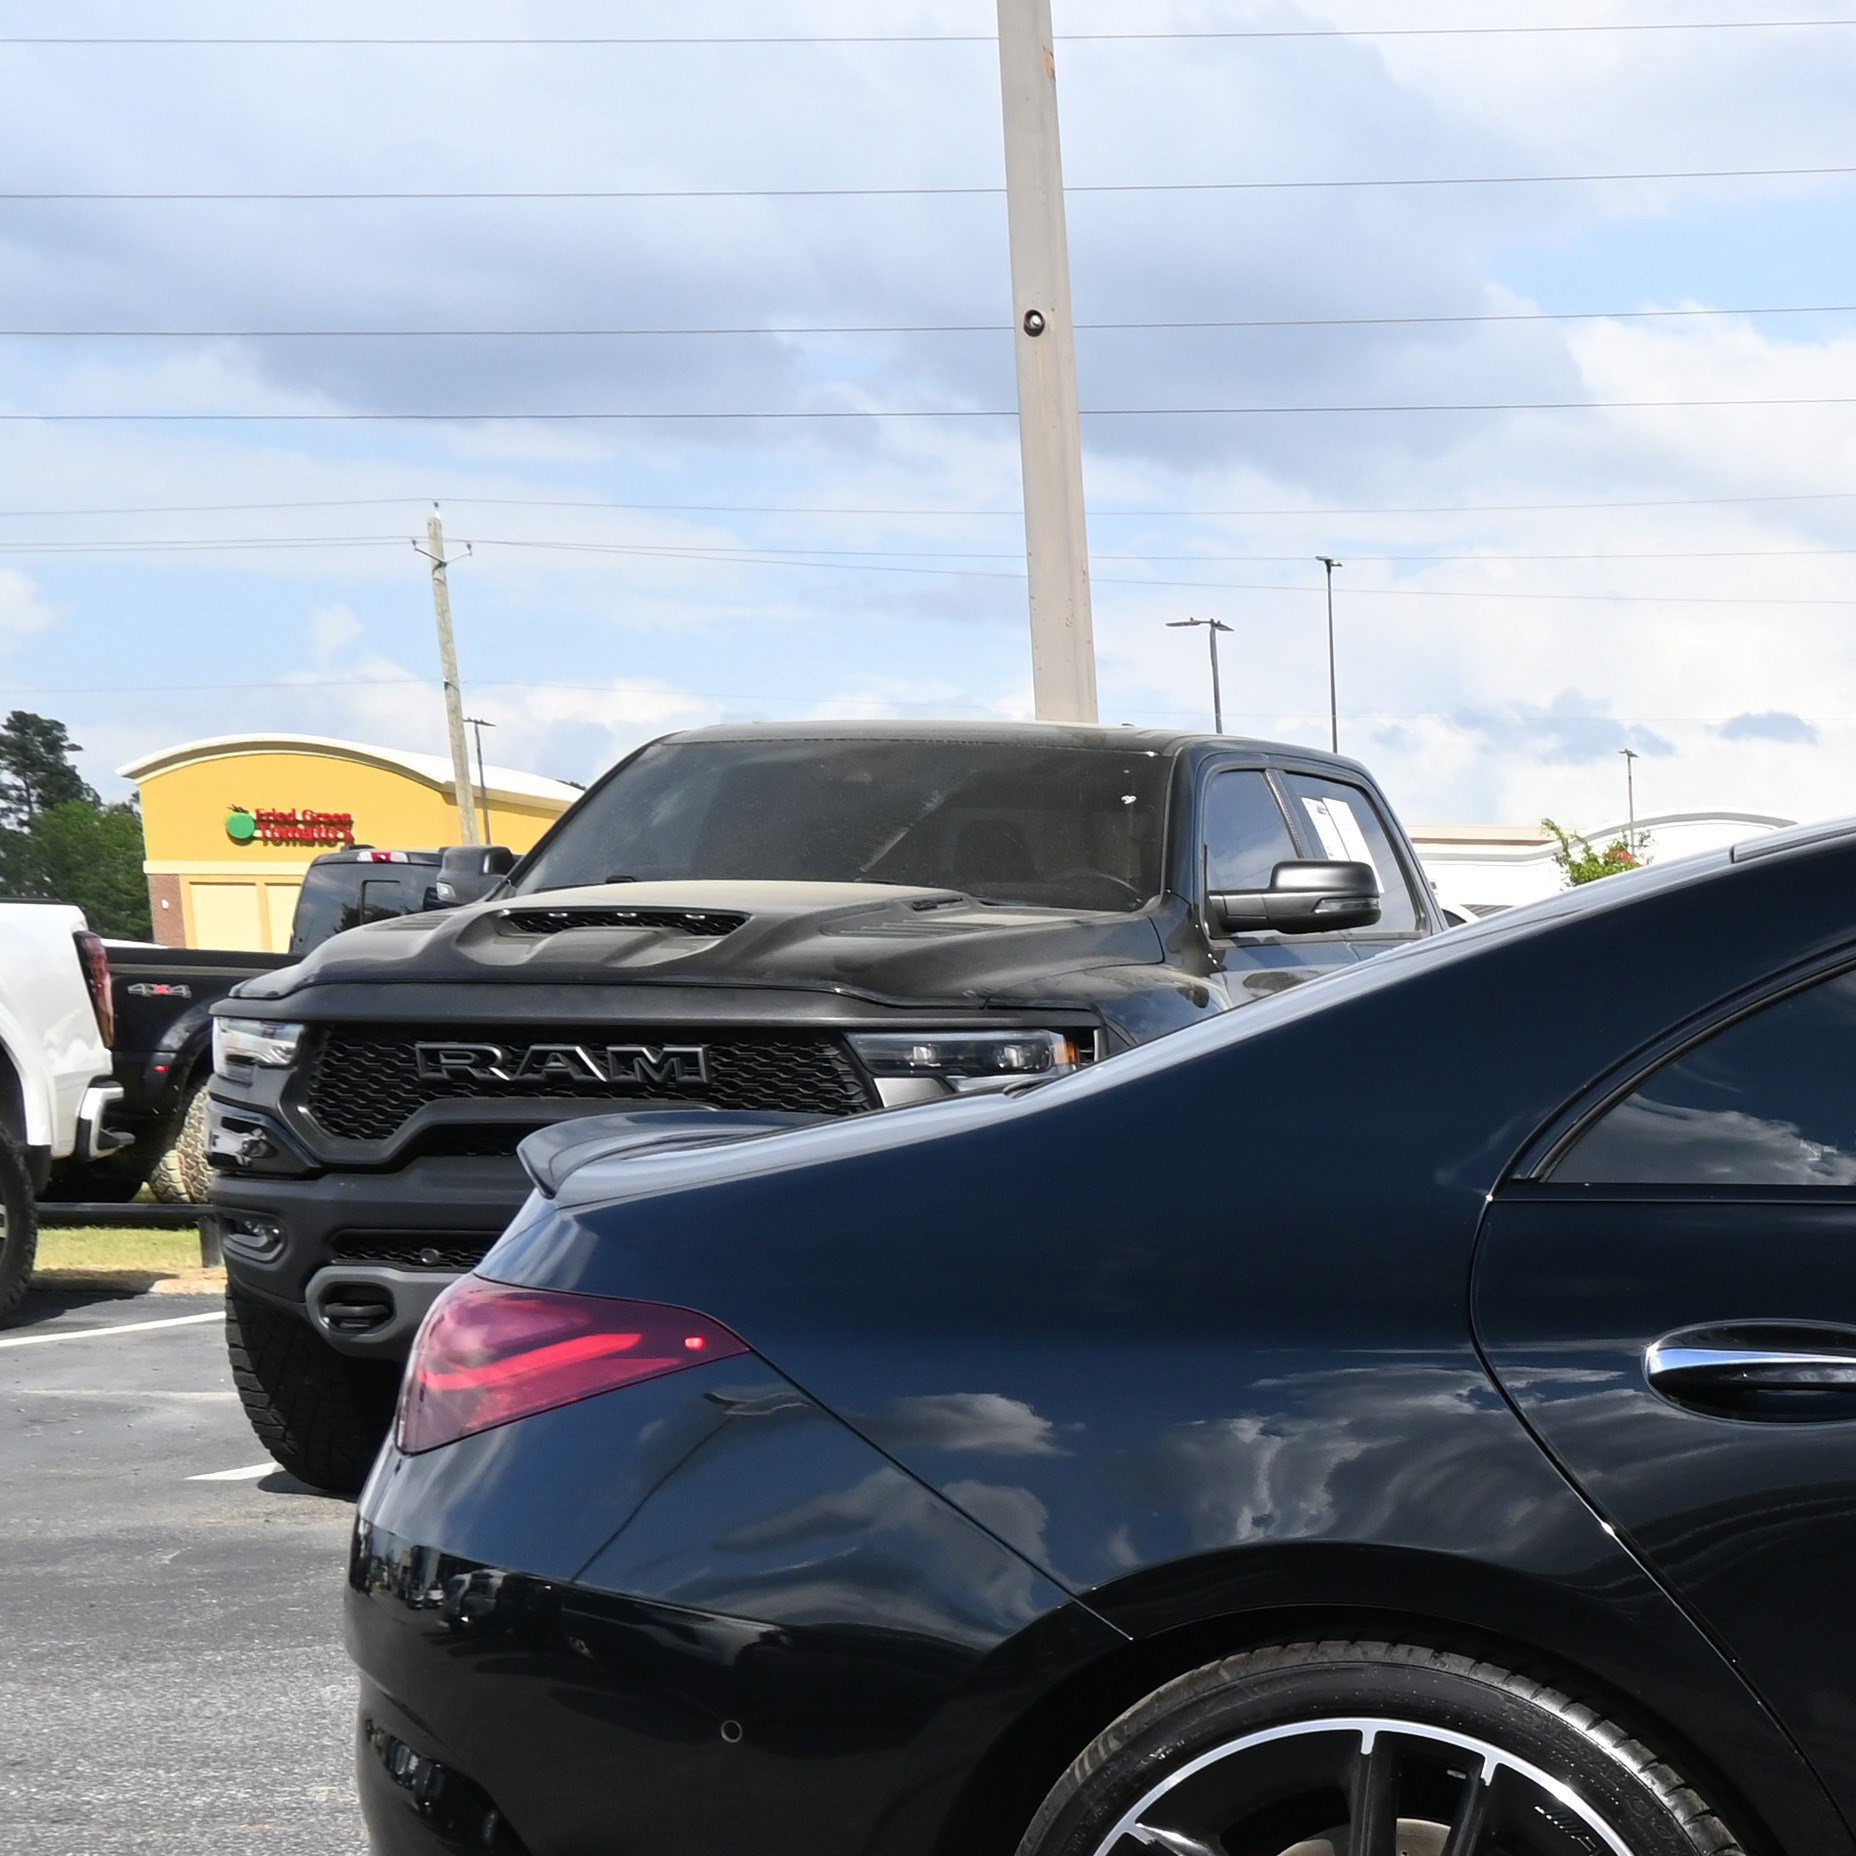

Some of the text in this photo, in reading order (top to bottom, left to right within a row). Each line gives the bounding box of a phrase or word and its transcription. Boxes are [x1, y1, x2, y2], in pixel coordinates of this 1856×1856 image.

[255, 807, 353, 823] Fried Green
[415, 1042, 708, 1083] RAM
